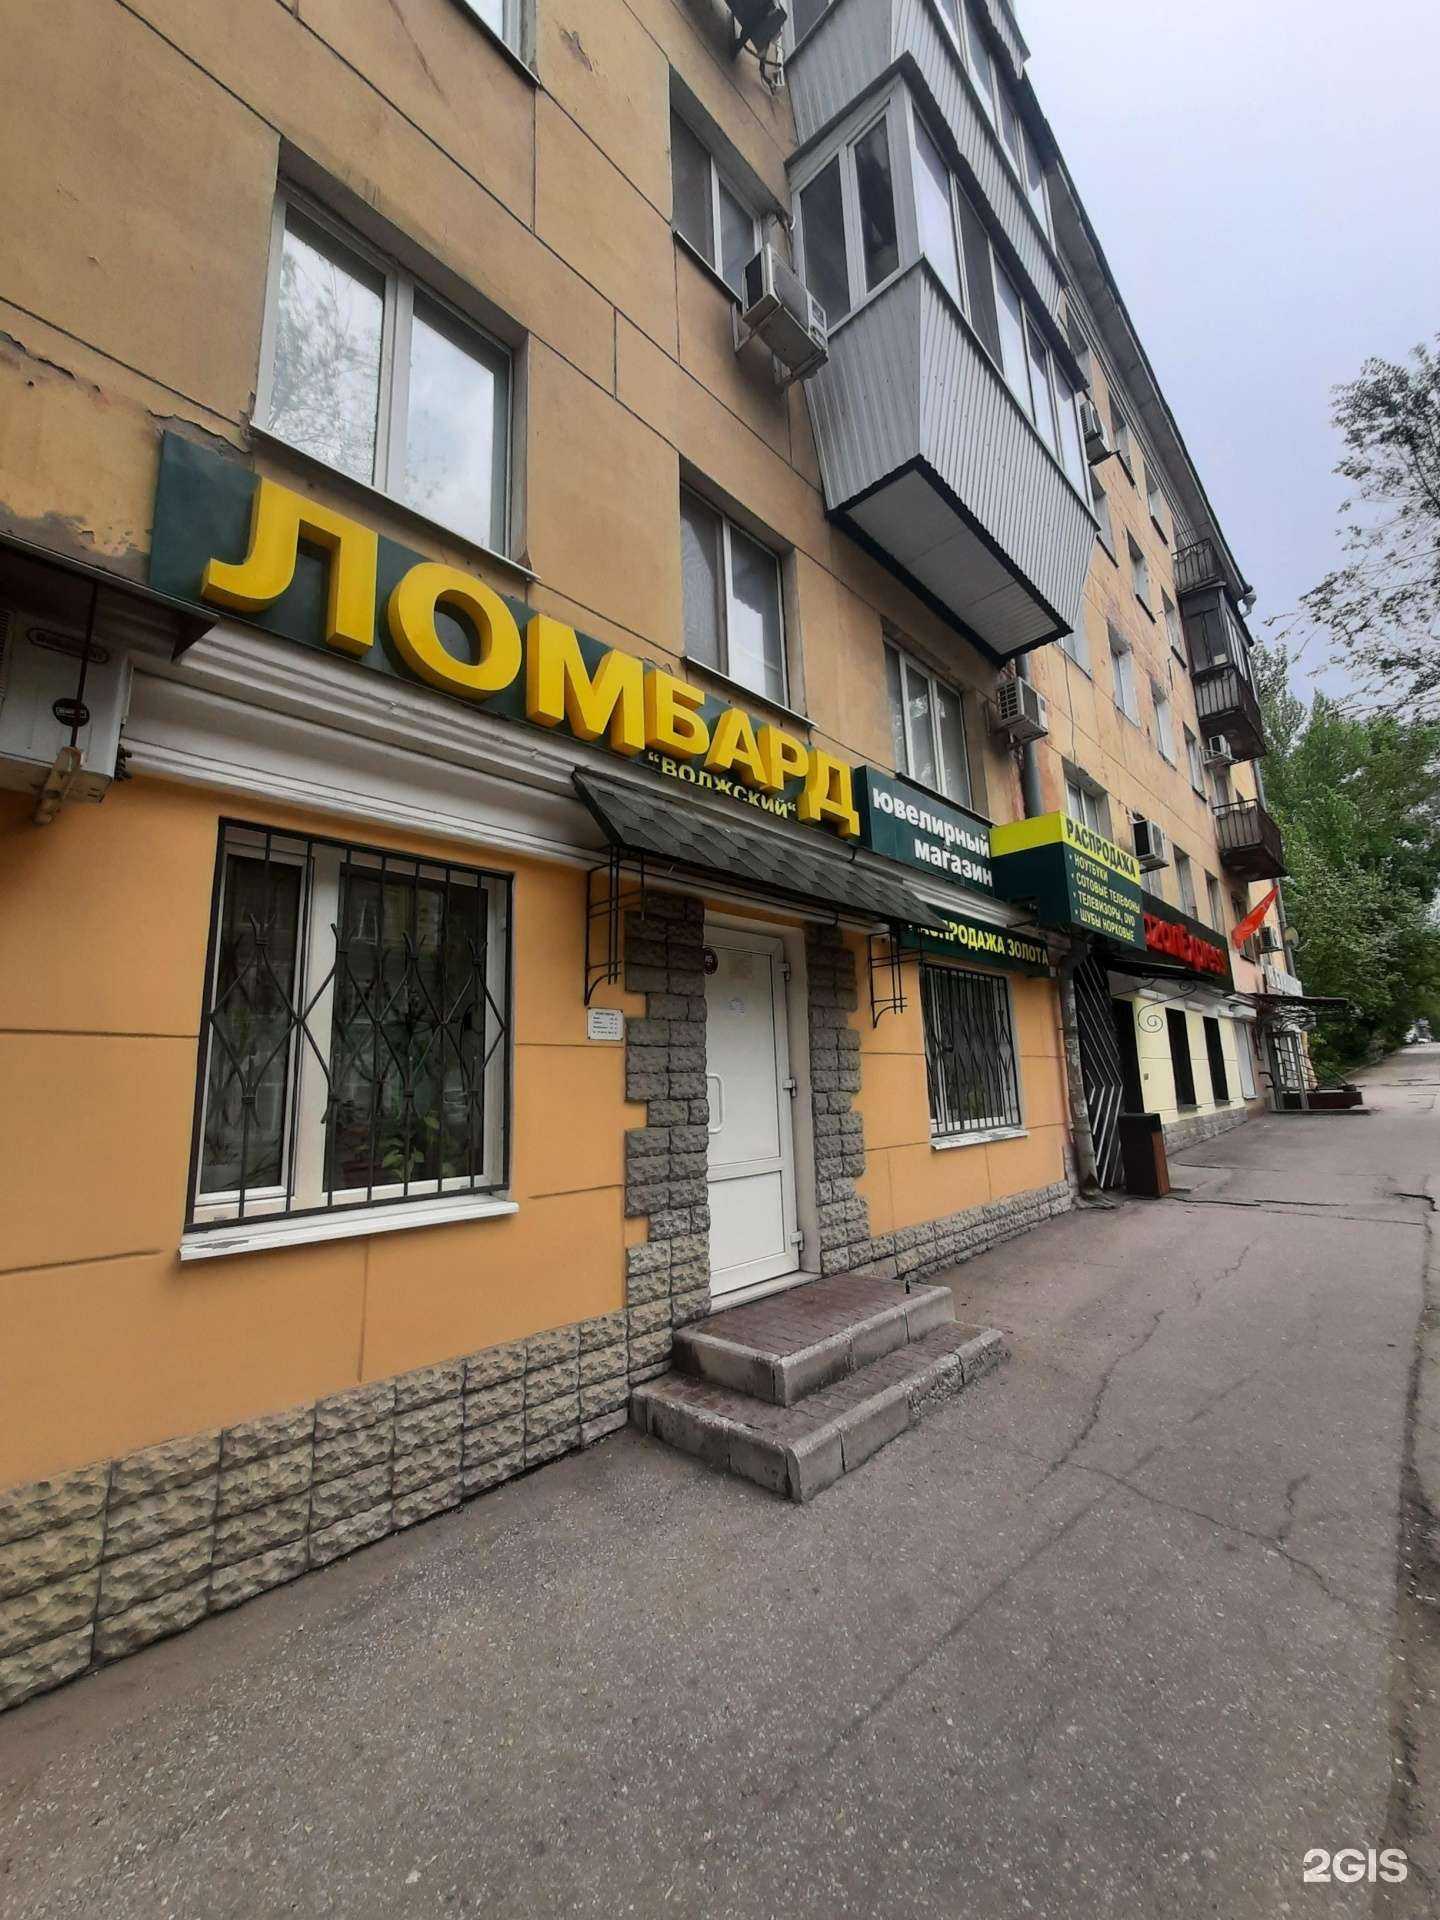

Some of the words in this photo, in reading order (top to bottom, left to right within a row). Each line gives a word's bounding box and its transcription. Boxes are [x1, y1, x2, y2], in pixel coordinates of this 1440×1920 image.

[201, 476, 861, 839] ЛОМБАРД
[872, 787, 991, 859] Ювелирный
[914, 838, 993, 887] магазин
[1066, 818, 1136, 878] РАСПРОДАЖА
[1074, 853, 1109, 882] НОУТБУКИ
[1076, 871, 1109, 899] СОТОВЫЕ
[1108, 888, 1141, 914] ТЕЛЕФОНЫ
[1079, 909, 1103, 929] ШУБЫ
[1102, 914, 1136, 942] НОРКОВЫЕ
[1007, 938, 1049, 967] ЗОЛОТА
